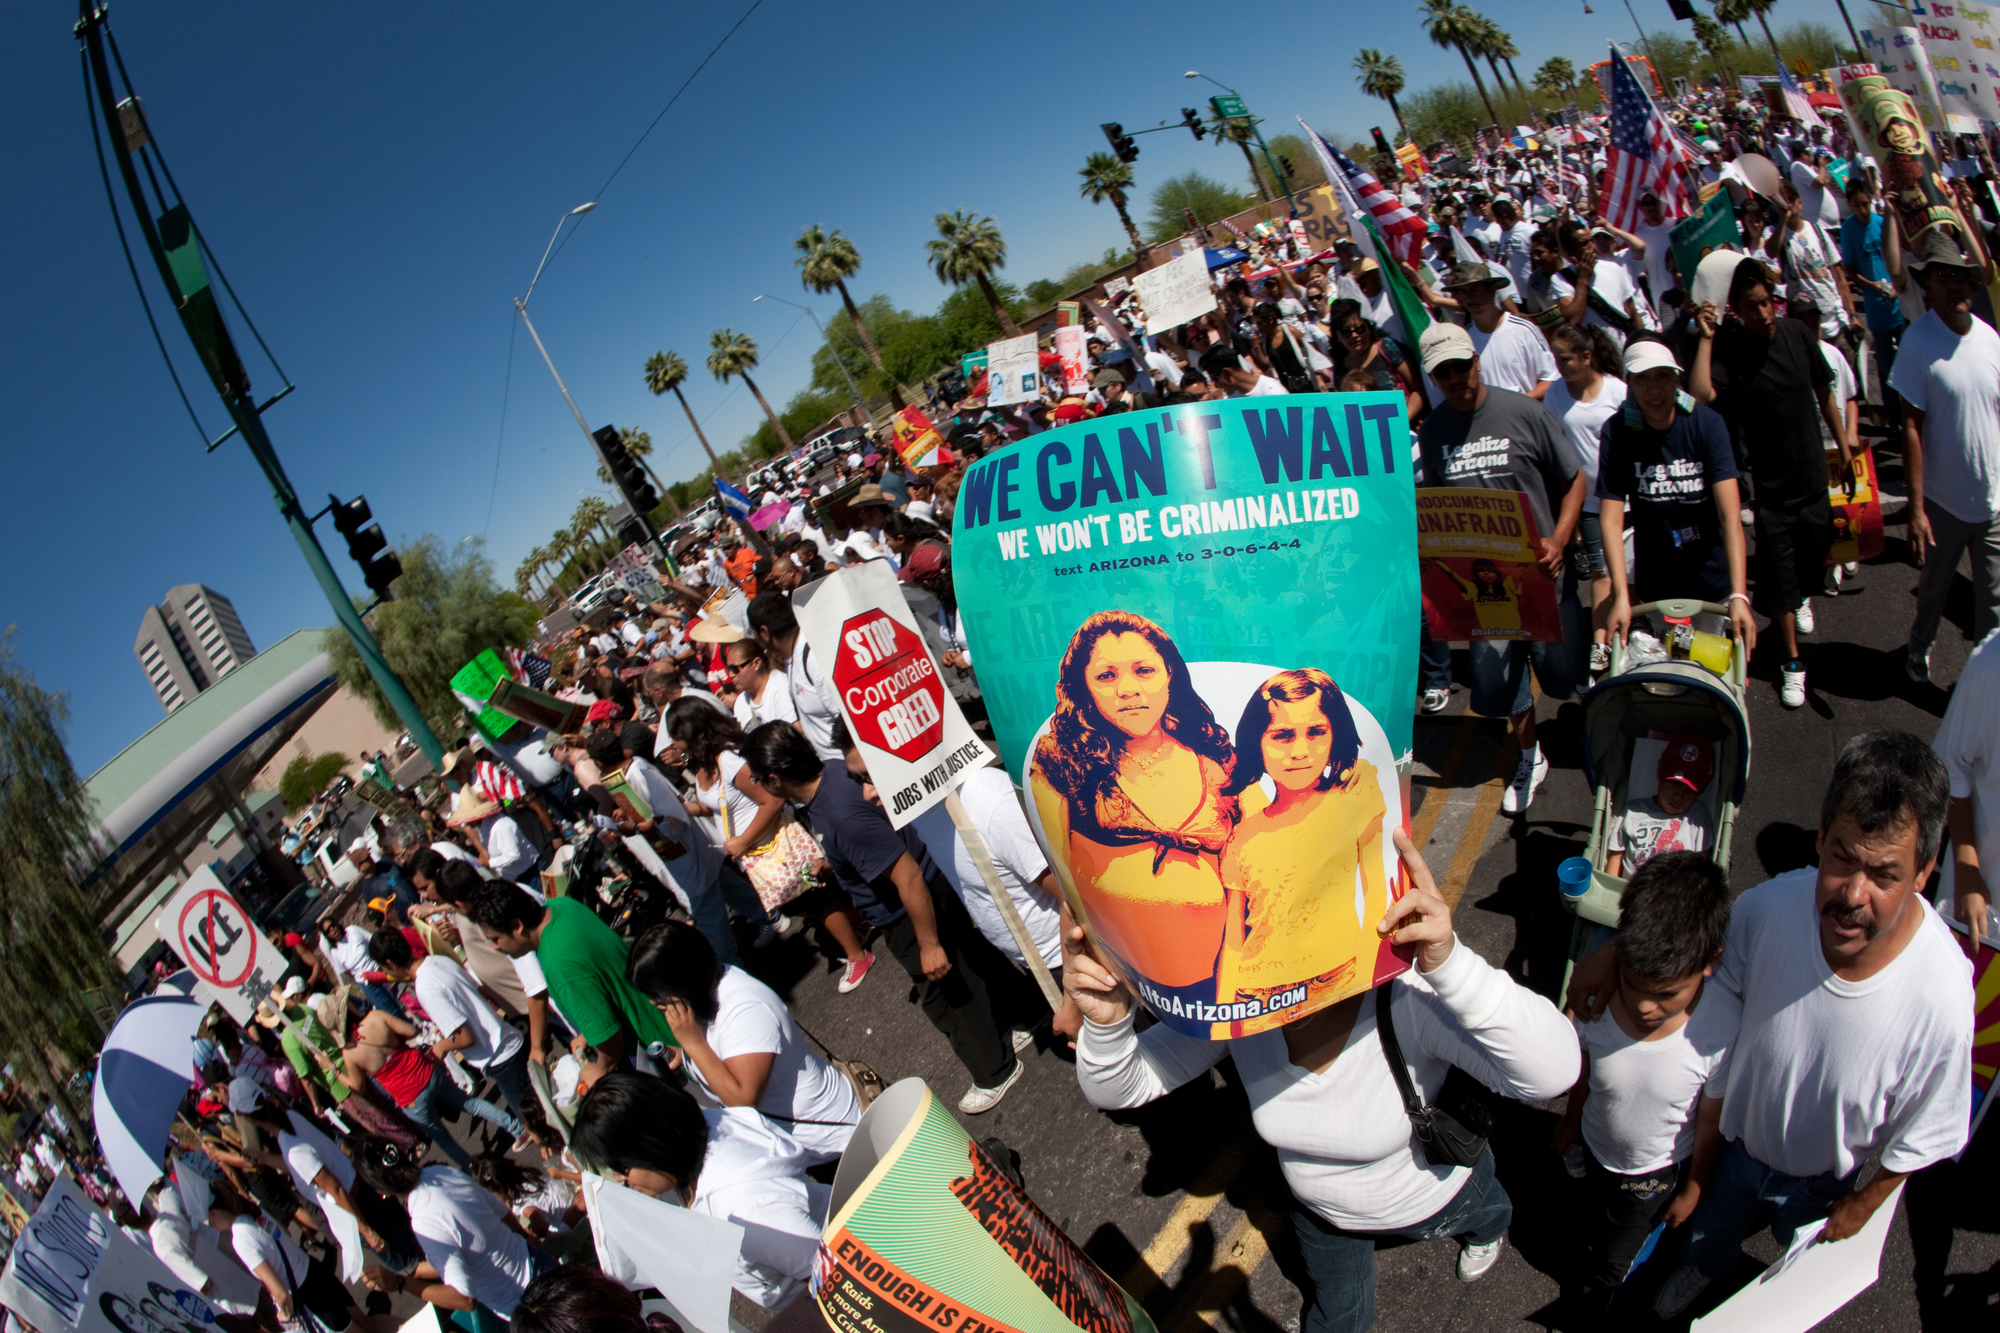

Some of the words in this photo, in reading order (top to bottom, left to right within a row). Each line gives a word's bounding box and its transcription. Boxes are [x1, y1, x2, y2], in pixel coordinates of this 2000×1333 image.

[1920, 22, 1961, 41] RACISM
[1137, 269, 1161, 291] WE
[1165, 258, 1187, 283] ARE
[1441, 435, 1511, 460] Legalize
[1444, 453, 1510, 474] Arizona
[964, 452, 1021, 530] WE
[1036, 412, 1220, 513] CAN'T
[1241, 403, 1399, 485] WAIT
[1633, 458, 1704, 481] Legalize
[1637, 478, 1706, 495] Arizona
[1416, 495, 1516, 513] NDOCUMENTED
[997, 529, 1030, 561] WE
[1035, 514, 1111, 556] WON'T
[1118, 509, 1153, 544] BE
[1159, 487, 1360, 538] CRIMINALIZED
[1417, 512, 1522, 538] UNAFRAID
[1054, 565, 1083, 576] text
[1088, 554, 1170, 573] ARIZONA
[1176, 551, 1194, 562] to
[1201, 538, 1301, 560] 3-0-6-4-4
[845, 616, 899, 670] STOP
[845, 656, 933, 715] Corporate
[876, 687, 941, 750] GREED
[892, 781, 923, 815] JOBS
[920, 763, 950, 795] WITH
[947, 739, 985, 777] JUSTICE
[1633, 826, 1664, 849] 27
[188, 901, 243, 973] ICE
[12, 1250, 79, 1322] NO
[836, 1238, 935, 1315] ENOUGH
[927, 1302, 960, 1328] IS
[841, 1280, 874, 1311] Raids
[826, 1301, 838, 1315] to
[833, 1292, 862, 1321] more
